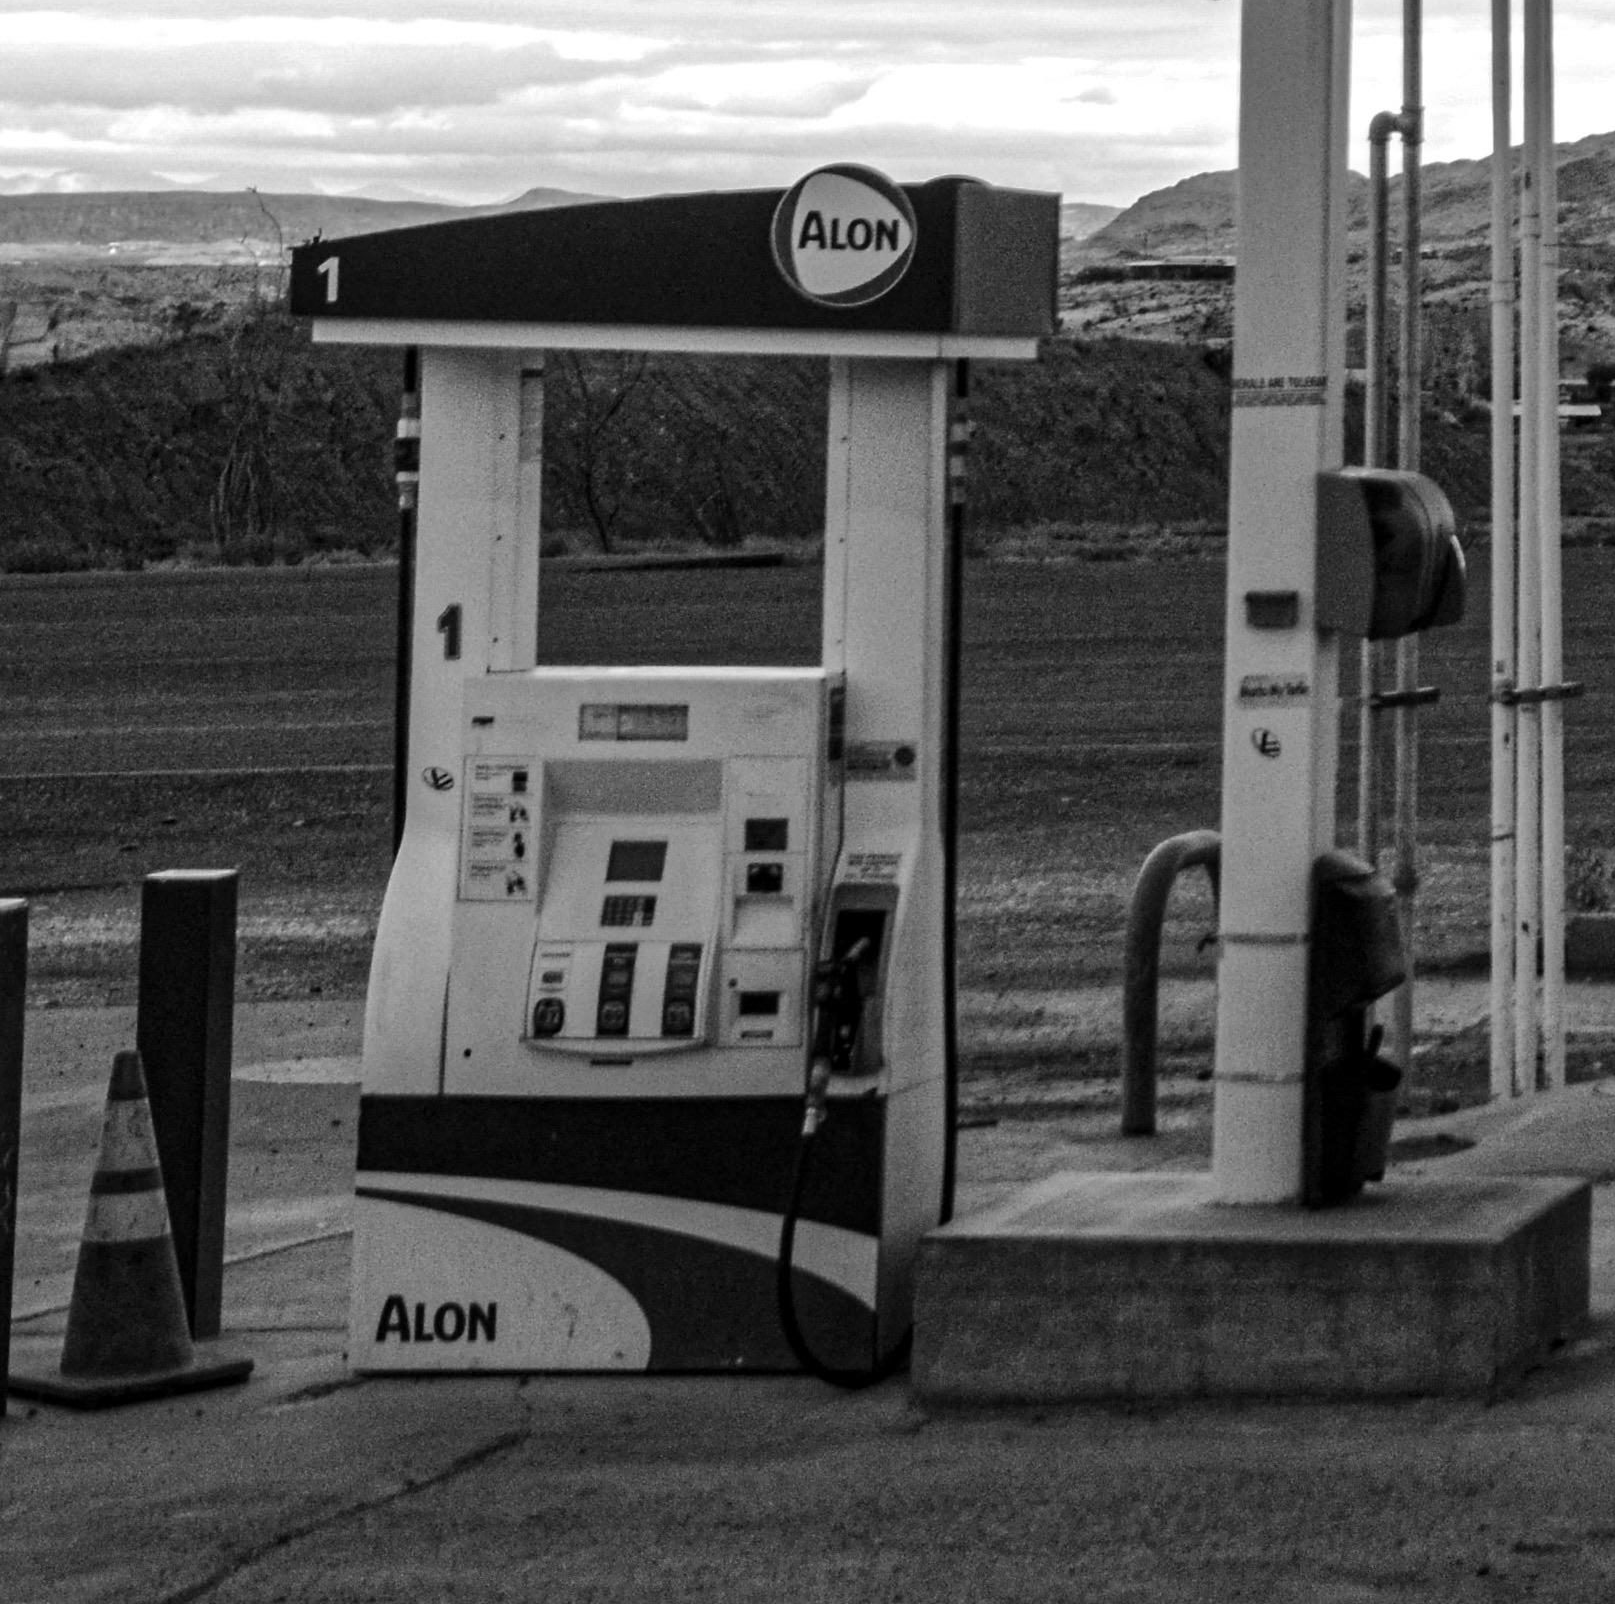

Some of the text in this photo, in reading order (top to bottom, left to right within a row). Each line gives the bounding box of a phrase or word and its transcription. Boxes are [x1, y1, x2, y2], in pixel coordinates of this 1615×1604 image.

[797, 209, 900, 254] ALON
[315, 256, 340, 304] 1
[436, 604, 463, 662] 1
[375, 1294, 497, 1342] ALON
